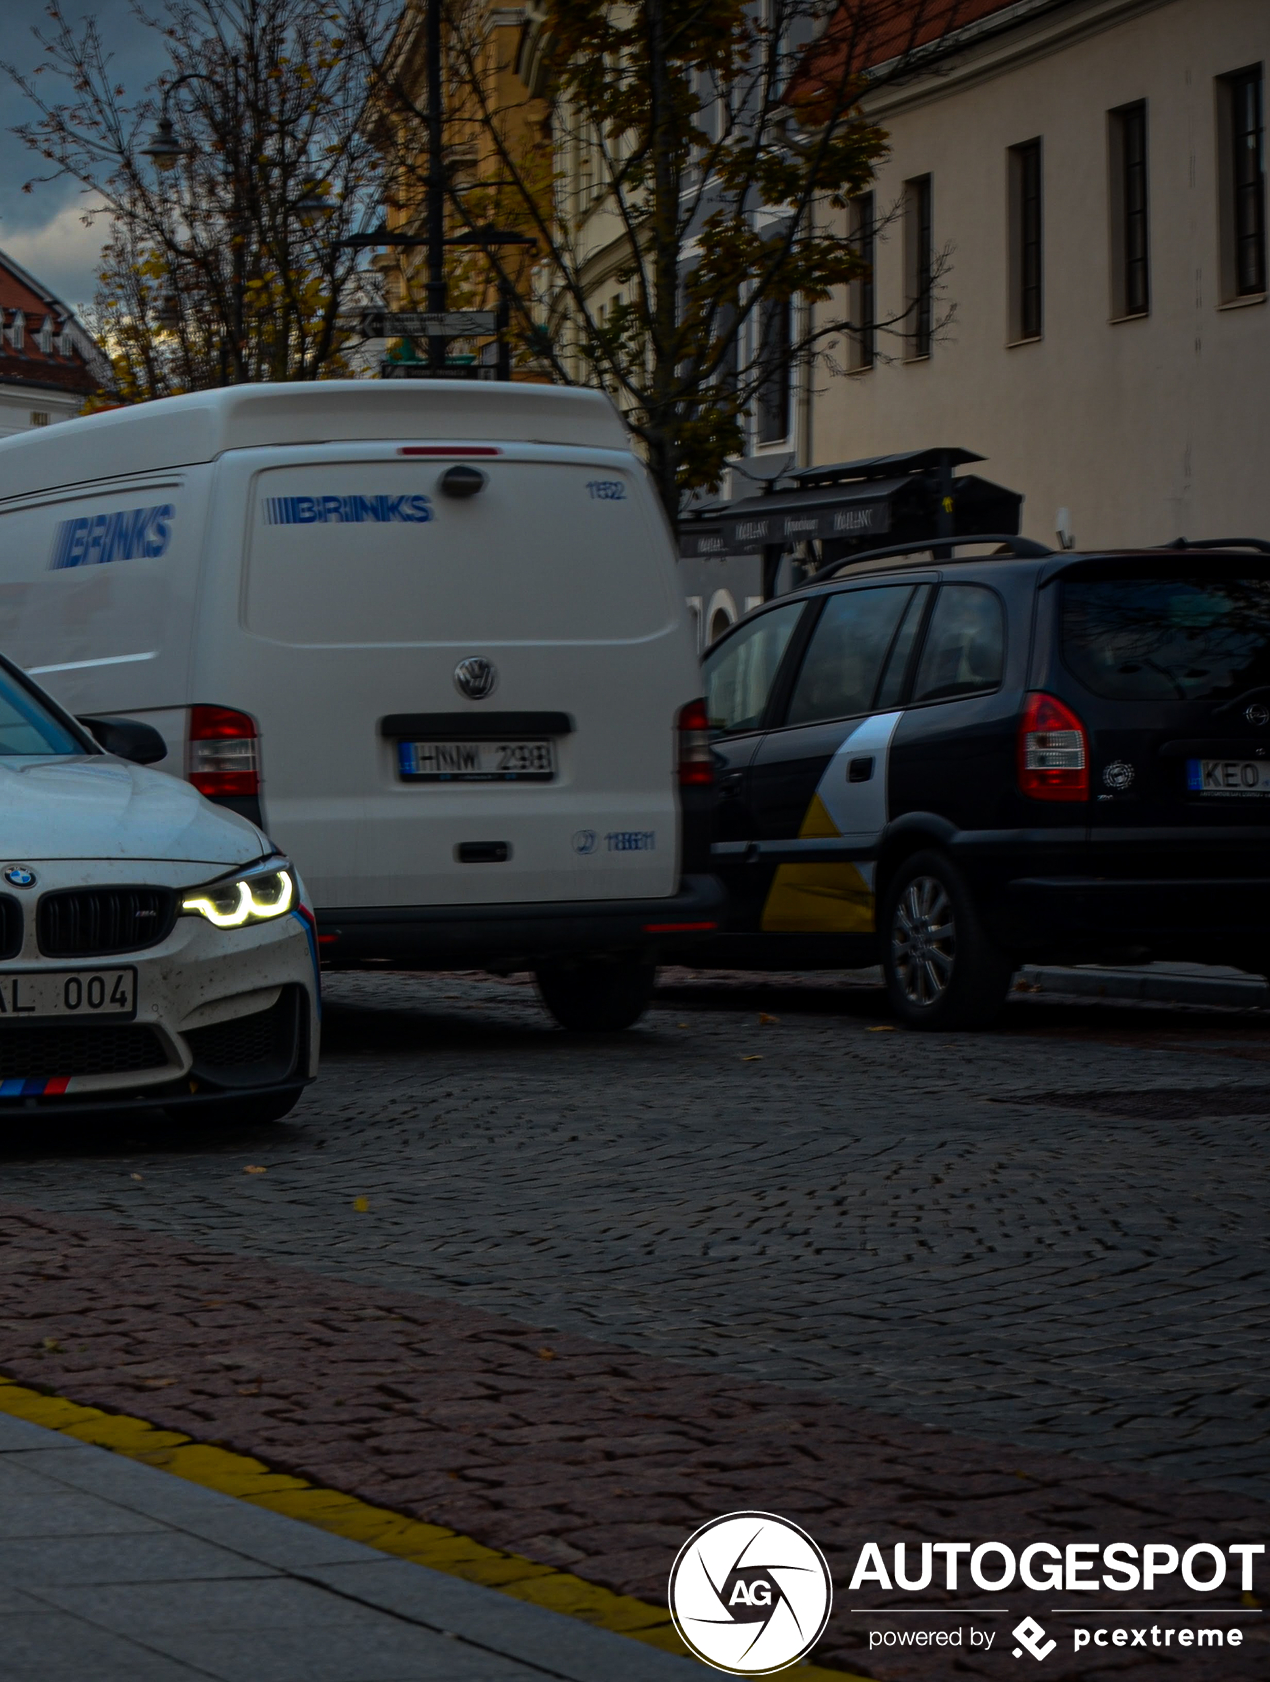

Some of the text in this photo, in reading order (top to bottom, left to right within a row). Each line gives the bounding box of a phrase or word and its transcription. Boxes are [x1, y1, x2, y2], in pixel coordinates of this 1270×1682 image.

[291, 494, 436, 523] BRINKS
[494, 744, 551, 771] 298
[1202, 761, 1260, 788] KEO
[64, 975, 128, 1010] 004
